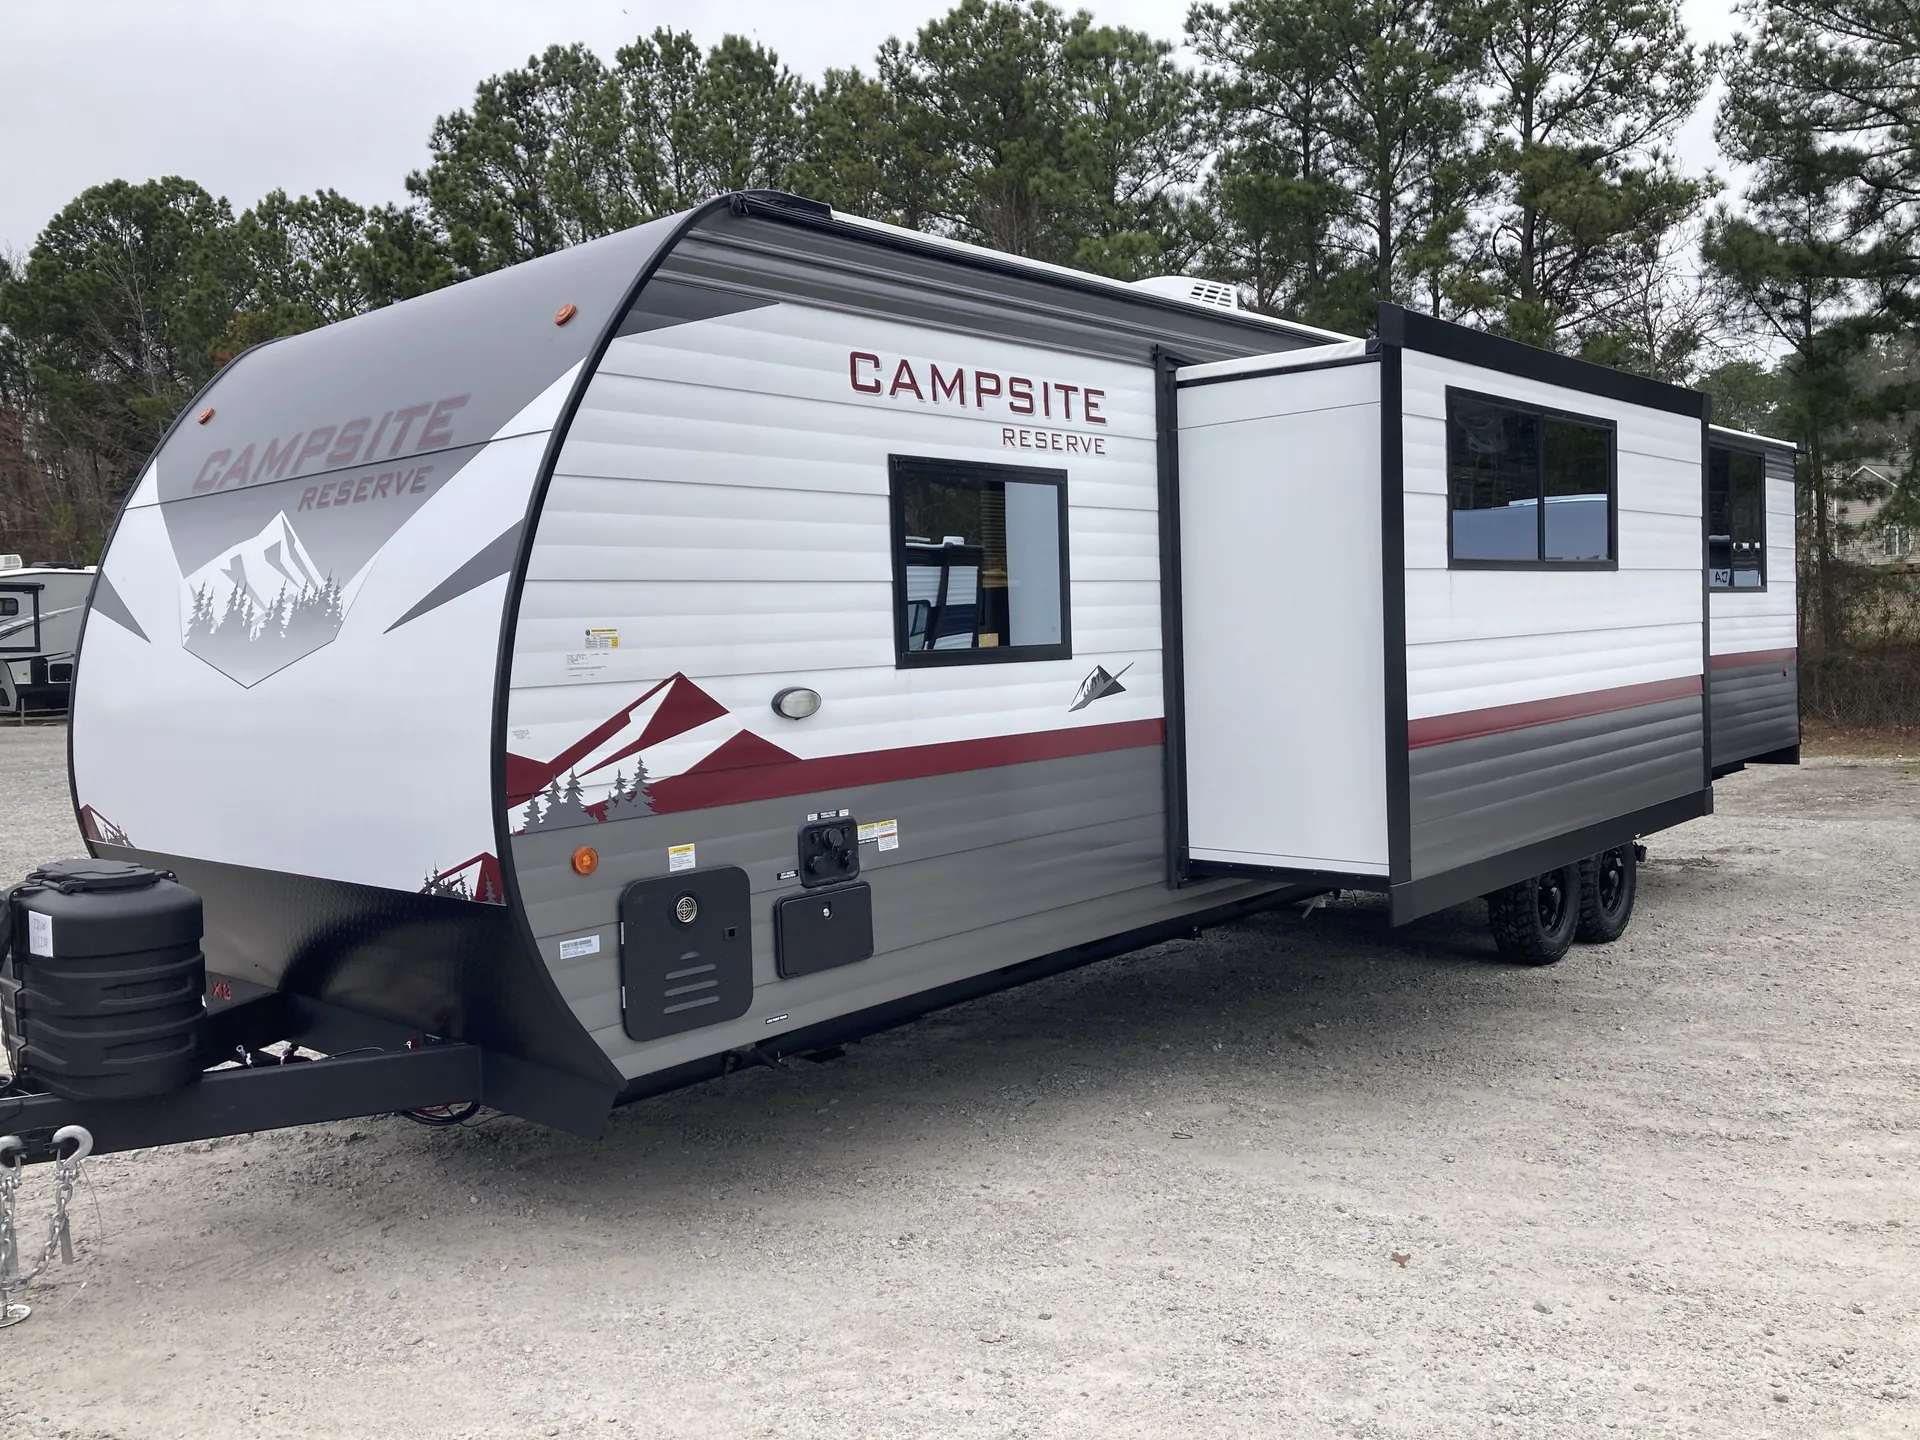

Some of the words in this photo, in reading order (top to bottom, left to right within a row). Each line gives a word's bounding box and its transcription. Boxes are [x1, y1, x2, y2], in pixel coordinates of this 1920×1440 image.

[850, 351, 1107, 424] CAMPSITE
[192, 393, 471, 493] CAMPSITE
[1002, 428, 1106, 455] RESERVE
[298, 466, 434, 512] RESERVE
